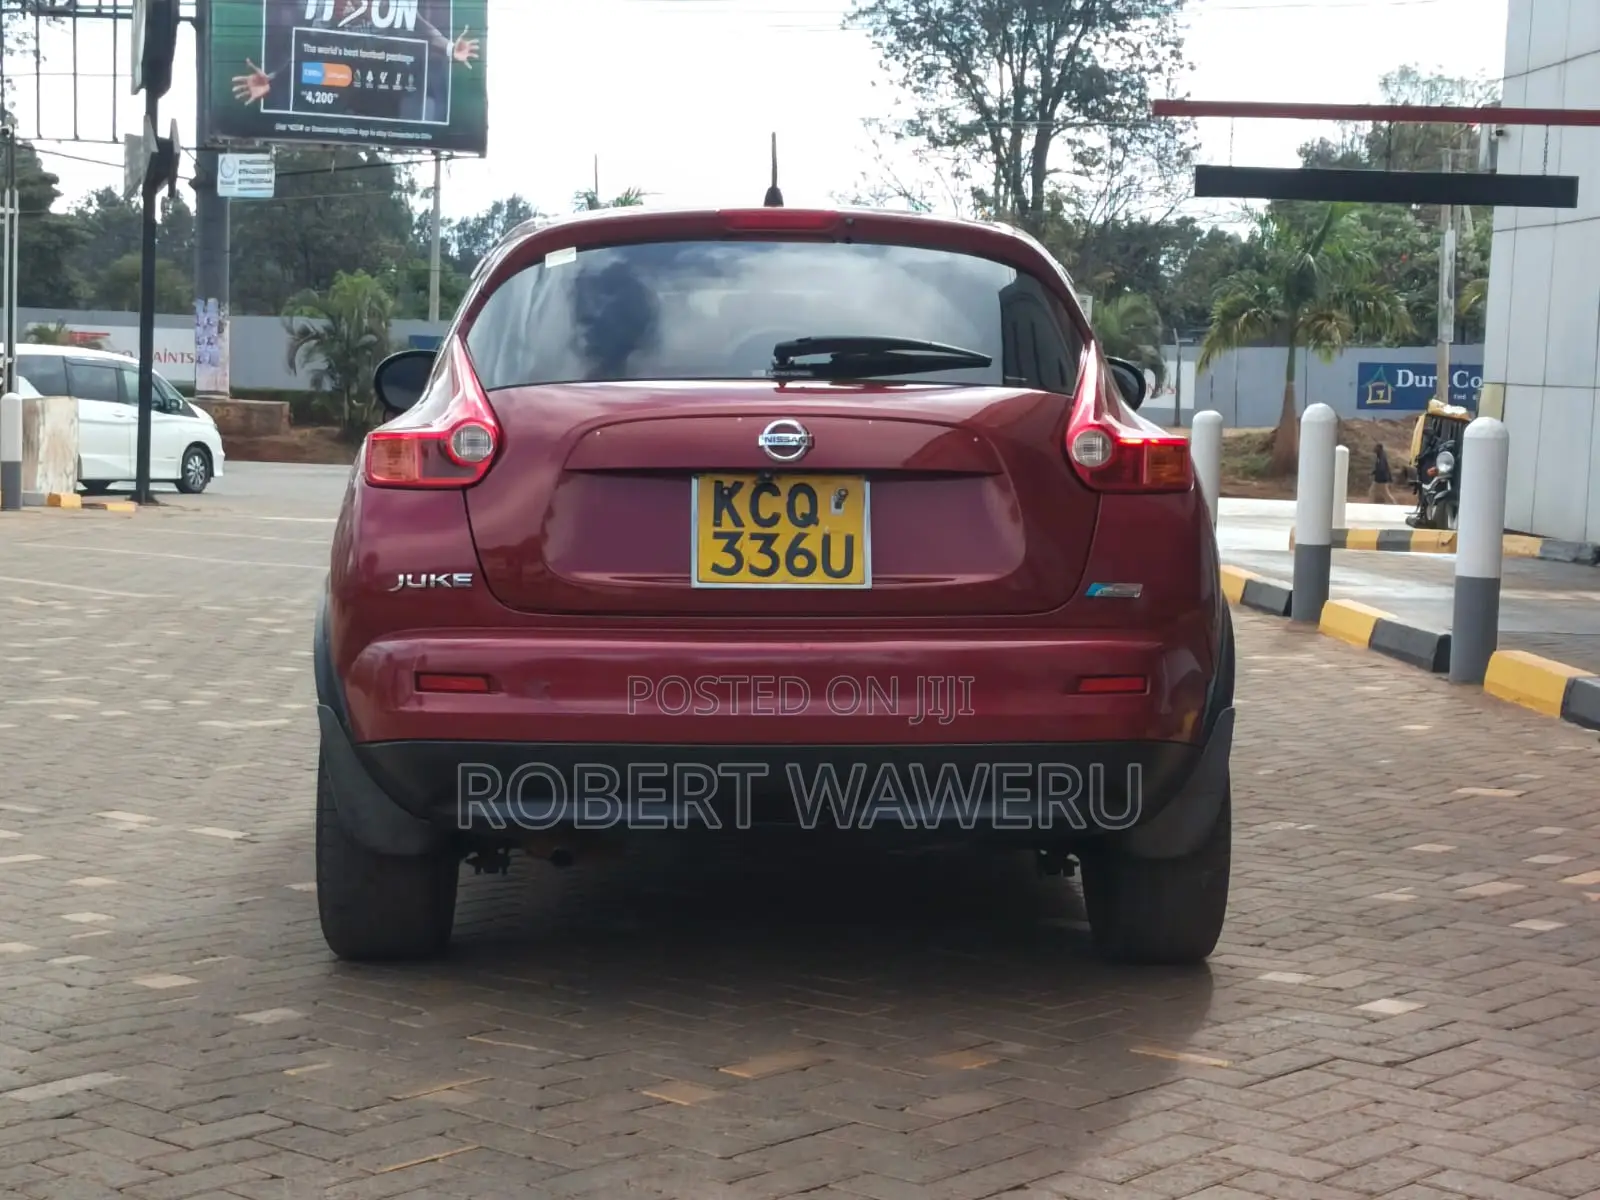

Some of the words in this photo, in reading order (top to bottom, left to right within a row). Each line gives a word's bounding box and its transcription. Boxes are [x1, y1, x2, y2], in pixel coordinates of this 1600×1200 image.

[1396, 369, 1449, 388] Dur
[764, 435, 806, 443] NISSAN
[712, 480, 819, 528] KCQ
[711, 531, 854, 579] 336U
[388, 573, 473, 592] JUKE
